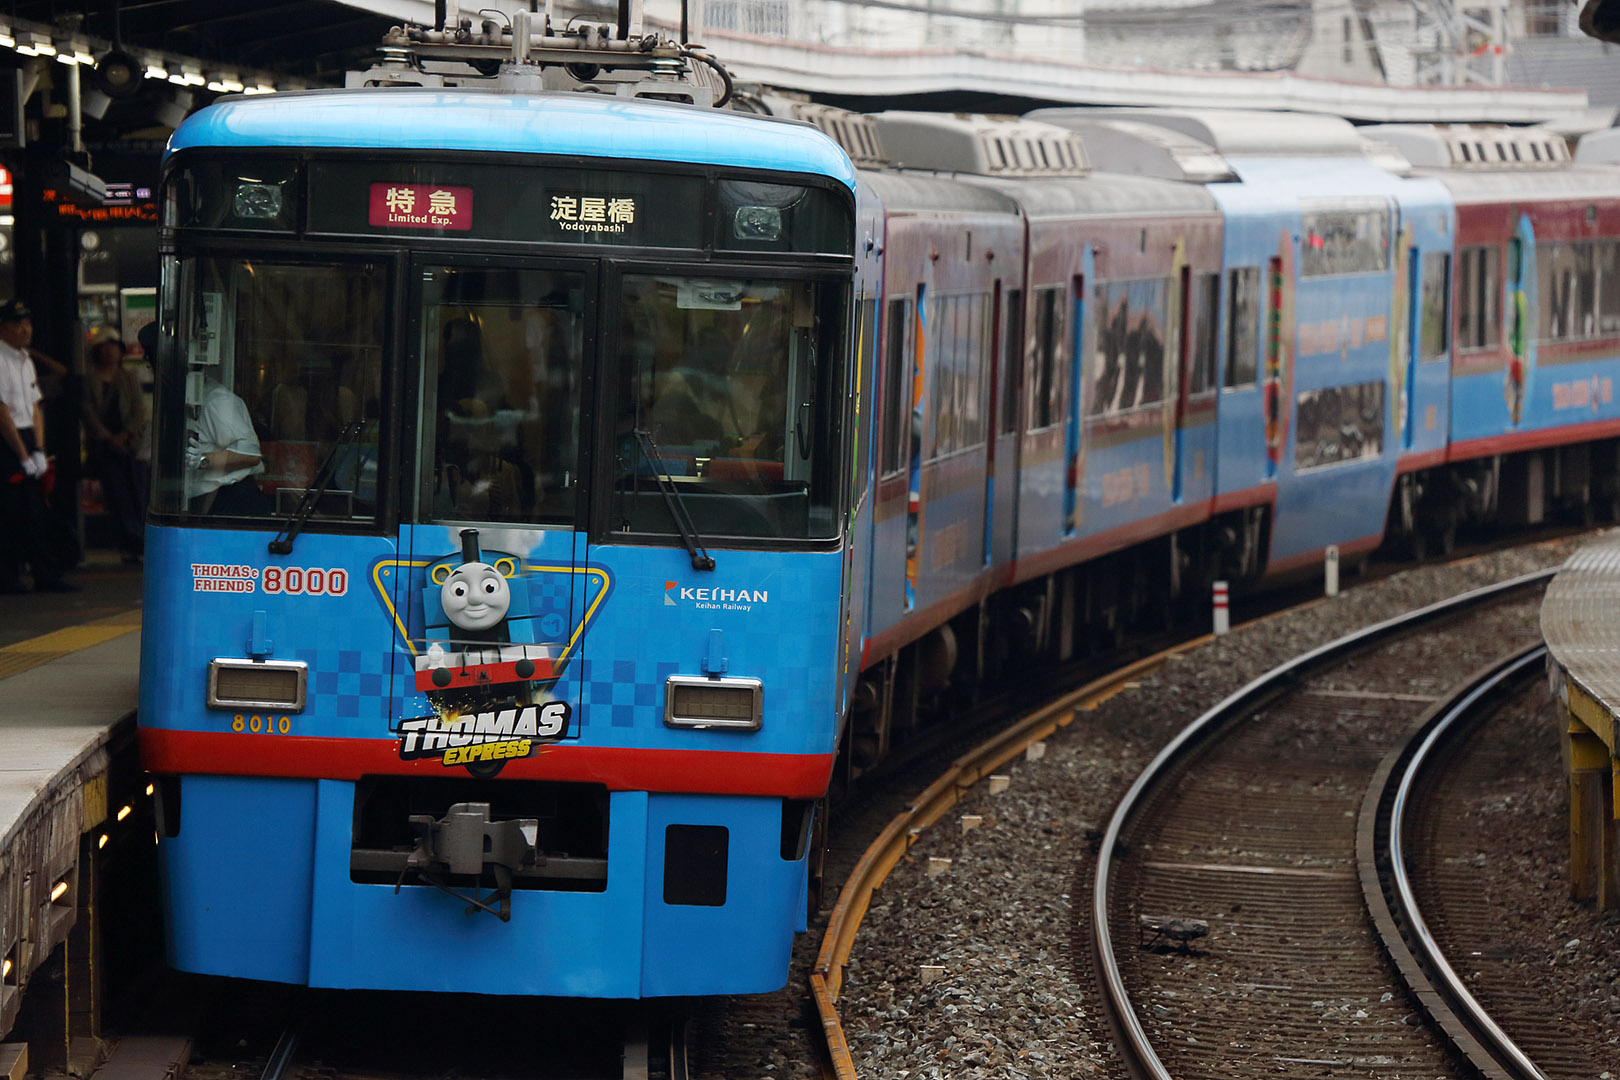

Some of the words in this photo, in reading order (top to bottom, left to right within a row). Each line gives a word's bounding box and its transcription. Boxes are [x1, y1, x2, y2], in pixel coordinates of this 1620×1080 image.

[386, 187, 457, 216] 特急
[550, 196, 635, 224] 淀屋橋
[388, 213, 427, 224] Limited
[431, 215, 453, 226] Exp.
[559, 221, 625, 233] Yodoyabashi
[192, 564, 250, 578] THOMAS
[262, 566, 348, 596] 8000
[194, 579, 255, 593] FRIENDS
[696, 602, 721, 610] Keihan
[722, 603, 752, 613] Railway
[232, 714, 291, 735] 8010
[402, 703, 566, 753] THOMAS
[442, 739, 532, 766] EXPRESS
